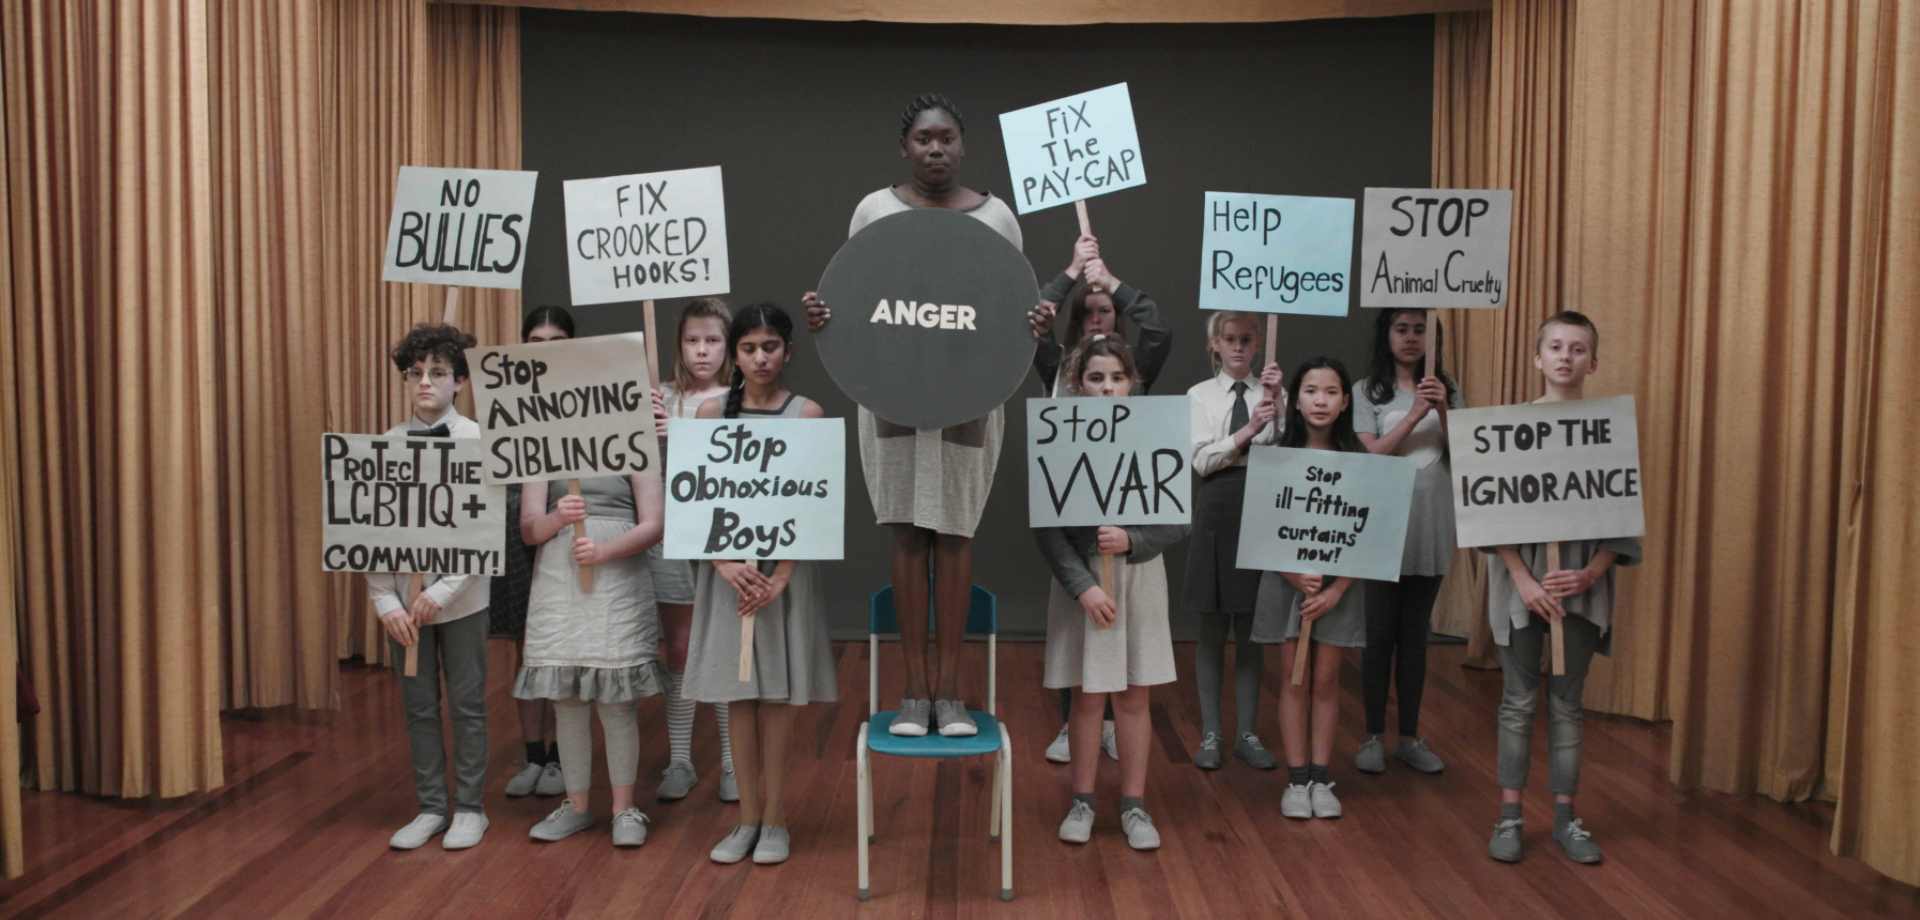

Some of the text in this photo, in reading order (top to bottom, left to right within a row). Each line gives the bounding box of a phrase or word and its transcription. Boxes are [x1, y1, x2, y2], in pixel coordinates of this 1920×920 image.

[1042, 136, 1100, 167] The
[440, 178, 480, 207] NO
[1024, 148, 1135, 206] PAY-GAP
[617, 181, 667, 217] FIX
[1390, 196, 1489, 237] STOP
[395, 211, 522, 274] BULLIES
[577, 217, 707, 260] CROOKED
[1212, 201, 1282, 245] Help
[614, 259, 710, 289] HOOKS!
[1212, 250, 1343, 303] Refugees
[1371, 250, 1501, 304] Animal Cruelty
[870, 299, 976, 331] ANGER
[480, 352, 547, 393] Stop
[486, 380, 642, 429] ANNOYING
[491, 431, 648, 479] SIBLINGS
[707, 424, 787, 471] Stop
[1474, 418, 1612, 453] STOP THE
[671, 465, 828, 502] Obnoxious
[1038, 448, 1185, 517] WAR
[1305, 466, 1342, 486] Stop
[1462, 468, 1638, 506] IGNORANCE
[1276, 487, 1369, 533] ill-fitting
[704, 507, 796, 556] Boys
[1277, 525, 1357, 548] curtains
[324, 544, 499, 575] COMMUNITY!
[1297, 545, 1341, 564] now!
